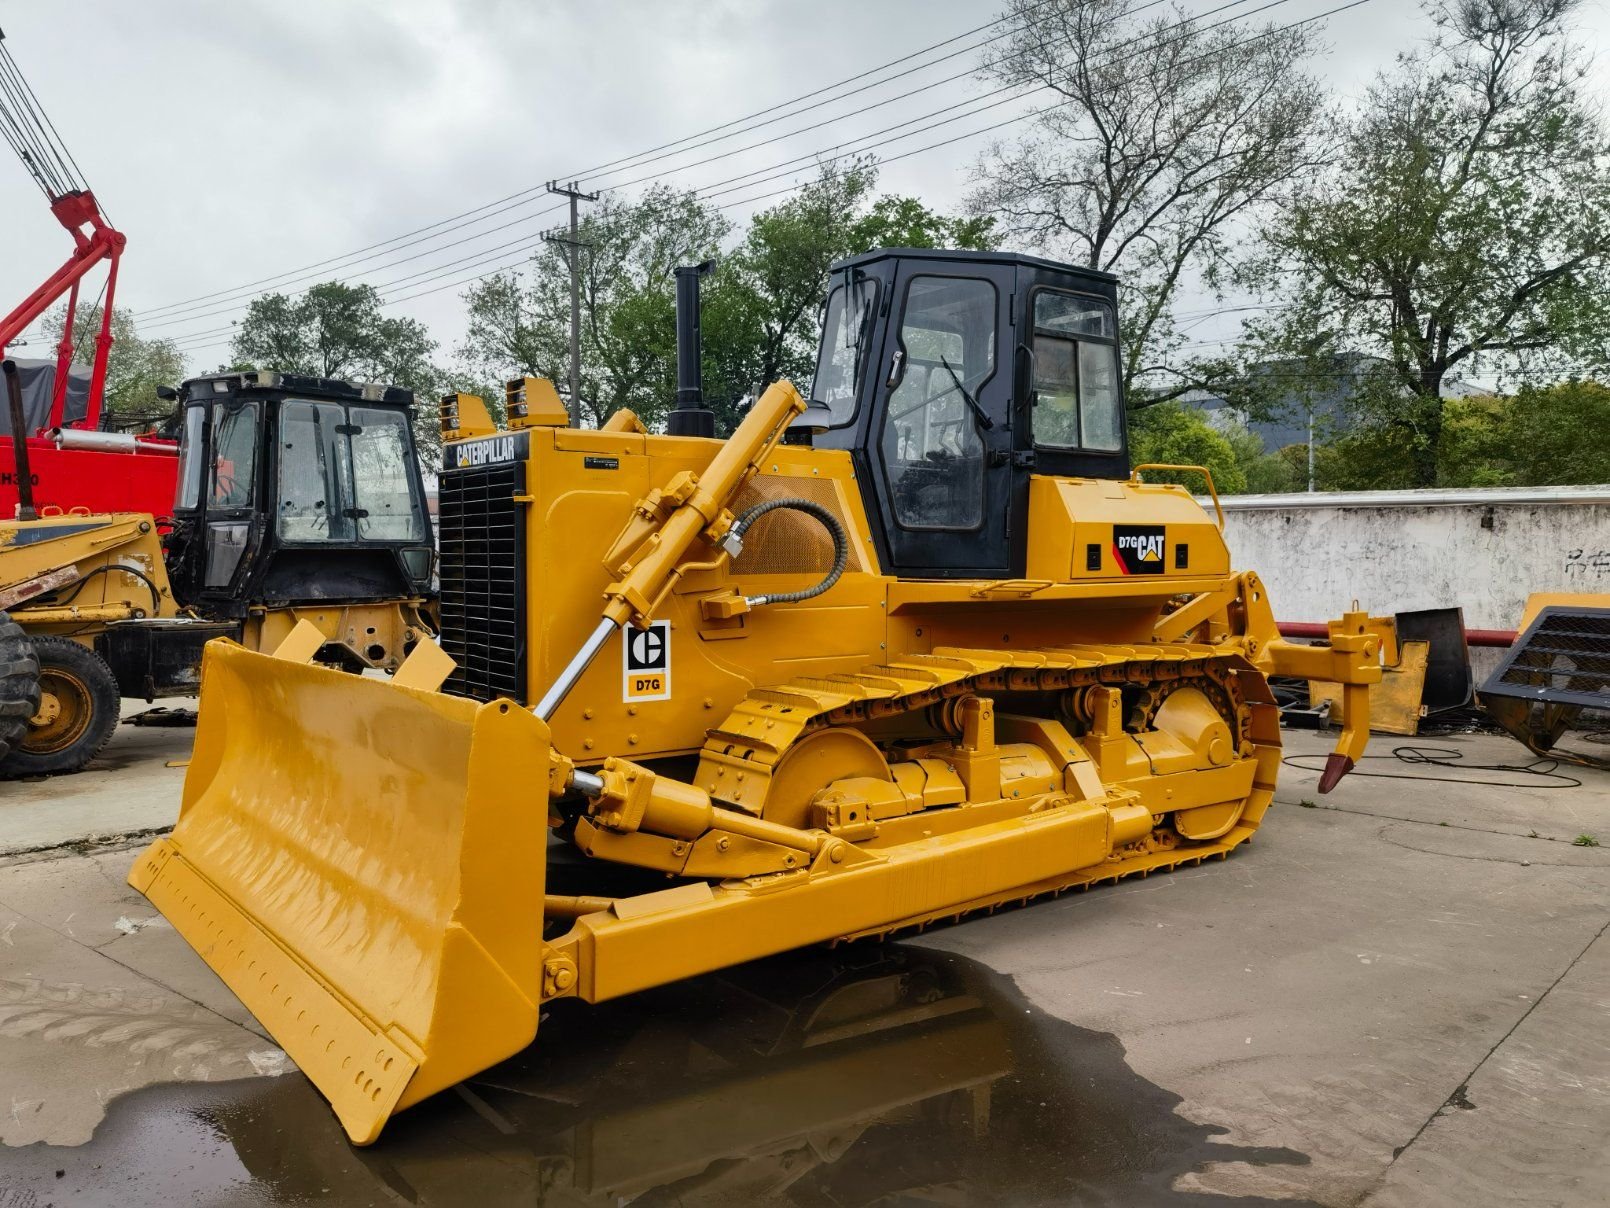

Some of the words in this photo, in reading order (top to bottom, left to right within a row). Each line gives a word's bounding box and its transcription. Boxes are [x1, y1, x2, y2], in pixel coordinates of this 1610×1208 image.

[456, 437, 515, 467] CATERPILLAR
[1118, 536, 1138, 549] D7G
[1137, 535, 1164, 561] CAT
[636, 679, 660, 691] D7G
